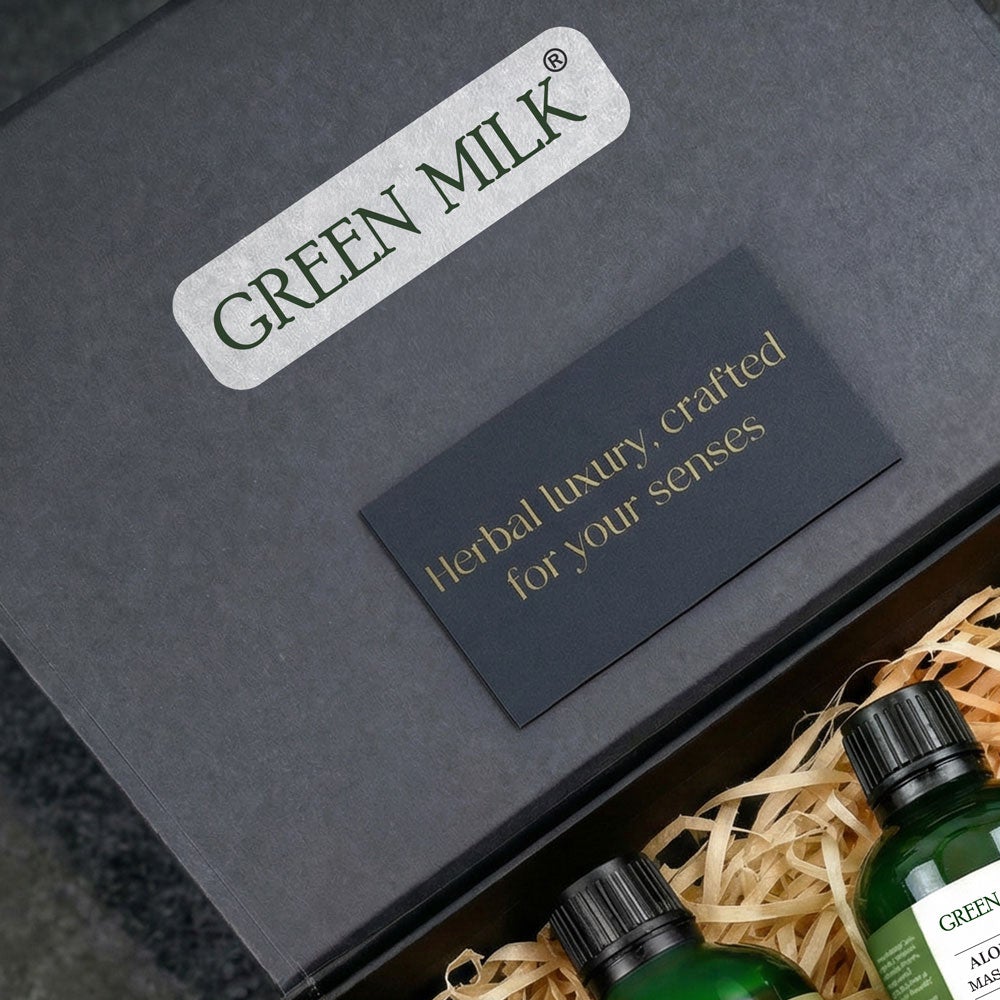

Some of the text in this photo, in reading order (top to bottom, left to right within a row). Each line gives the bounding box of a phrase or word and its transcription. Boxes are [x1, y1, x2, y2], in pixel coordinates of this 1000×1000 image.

[214, 185, 421, 349] GREEN
[426, 330, 786, 591] Herbal luxury, crafted
[507, 416, 764, 599] for your senses
[939, 892, 1000, 931] GREEN
